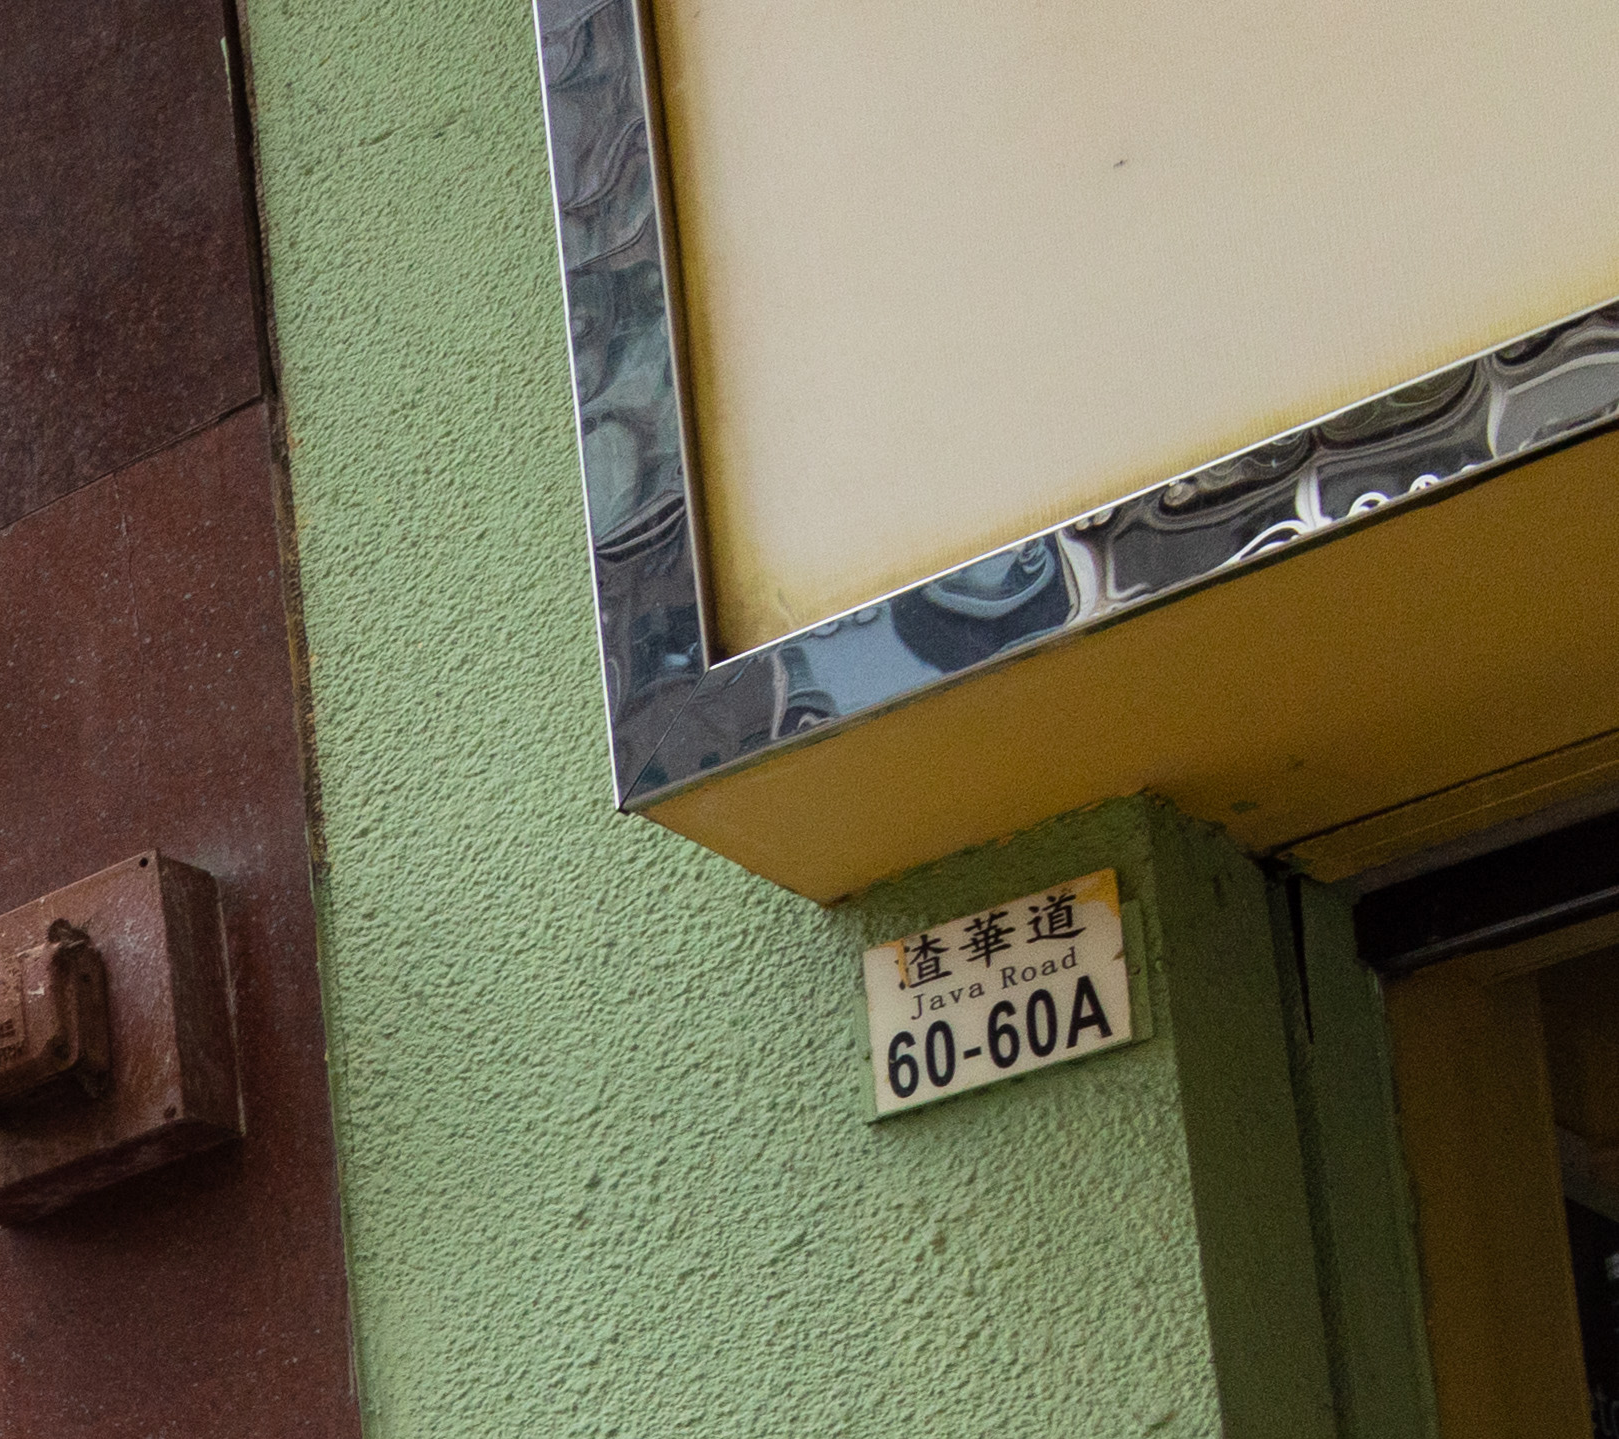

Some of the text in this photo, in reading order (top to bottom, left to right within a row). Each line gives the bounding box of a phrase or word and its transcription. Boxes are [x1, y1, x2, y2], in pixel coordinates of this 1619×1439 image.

[897, 892, 1087, 991] 渣華道
[910, 946, 1079, 1021] Java Road
[887, 975, 1113, 1099] 60-60A
